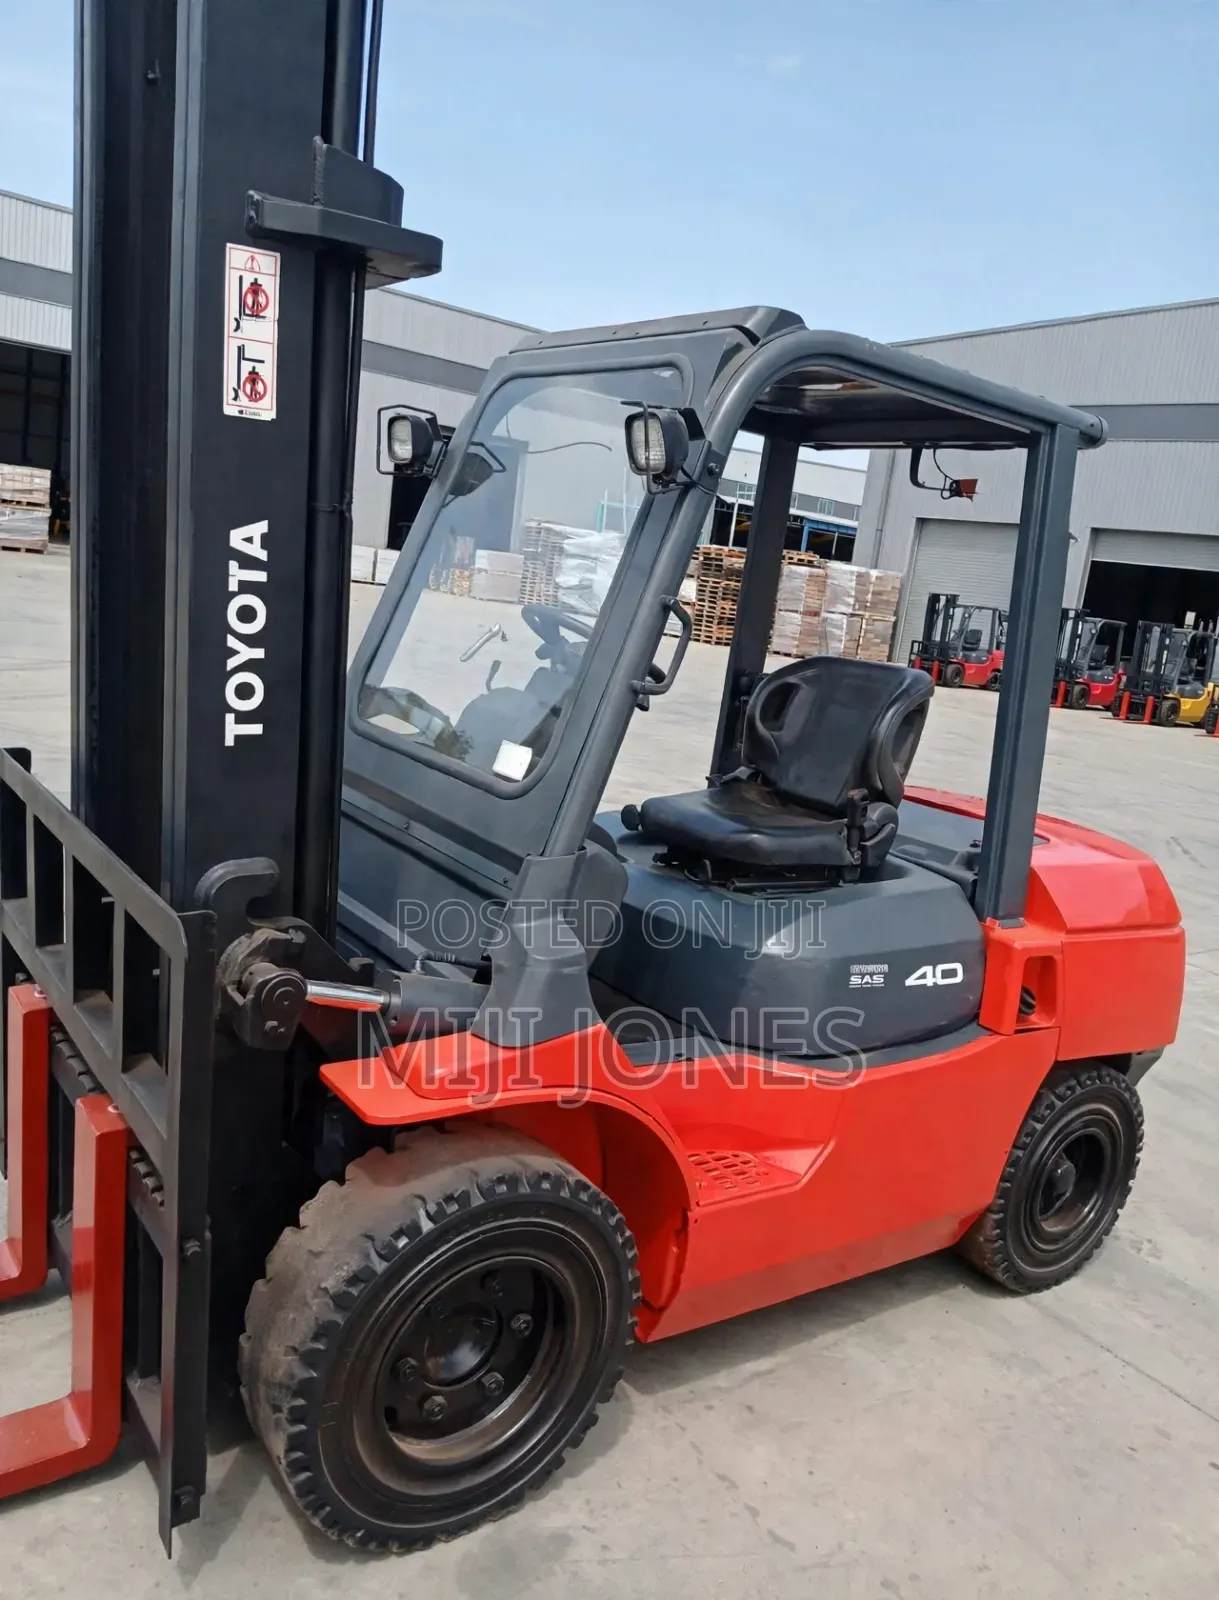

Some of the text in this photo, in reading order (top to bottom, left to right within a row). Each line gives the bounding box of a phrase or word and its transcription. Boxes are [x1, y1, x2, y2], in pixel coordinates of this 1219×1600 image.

[224, 519, 269, 747] TOYOTA
[849, 974, 885, 985] SAS
[905, 962, 963, 986] 40
